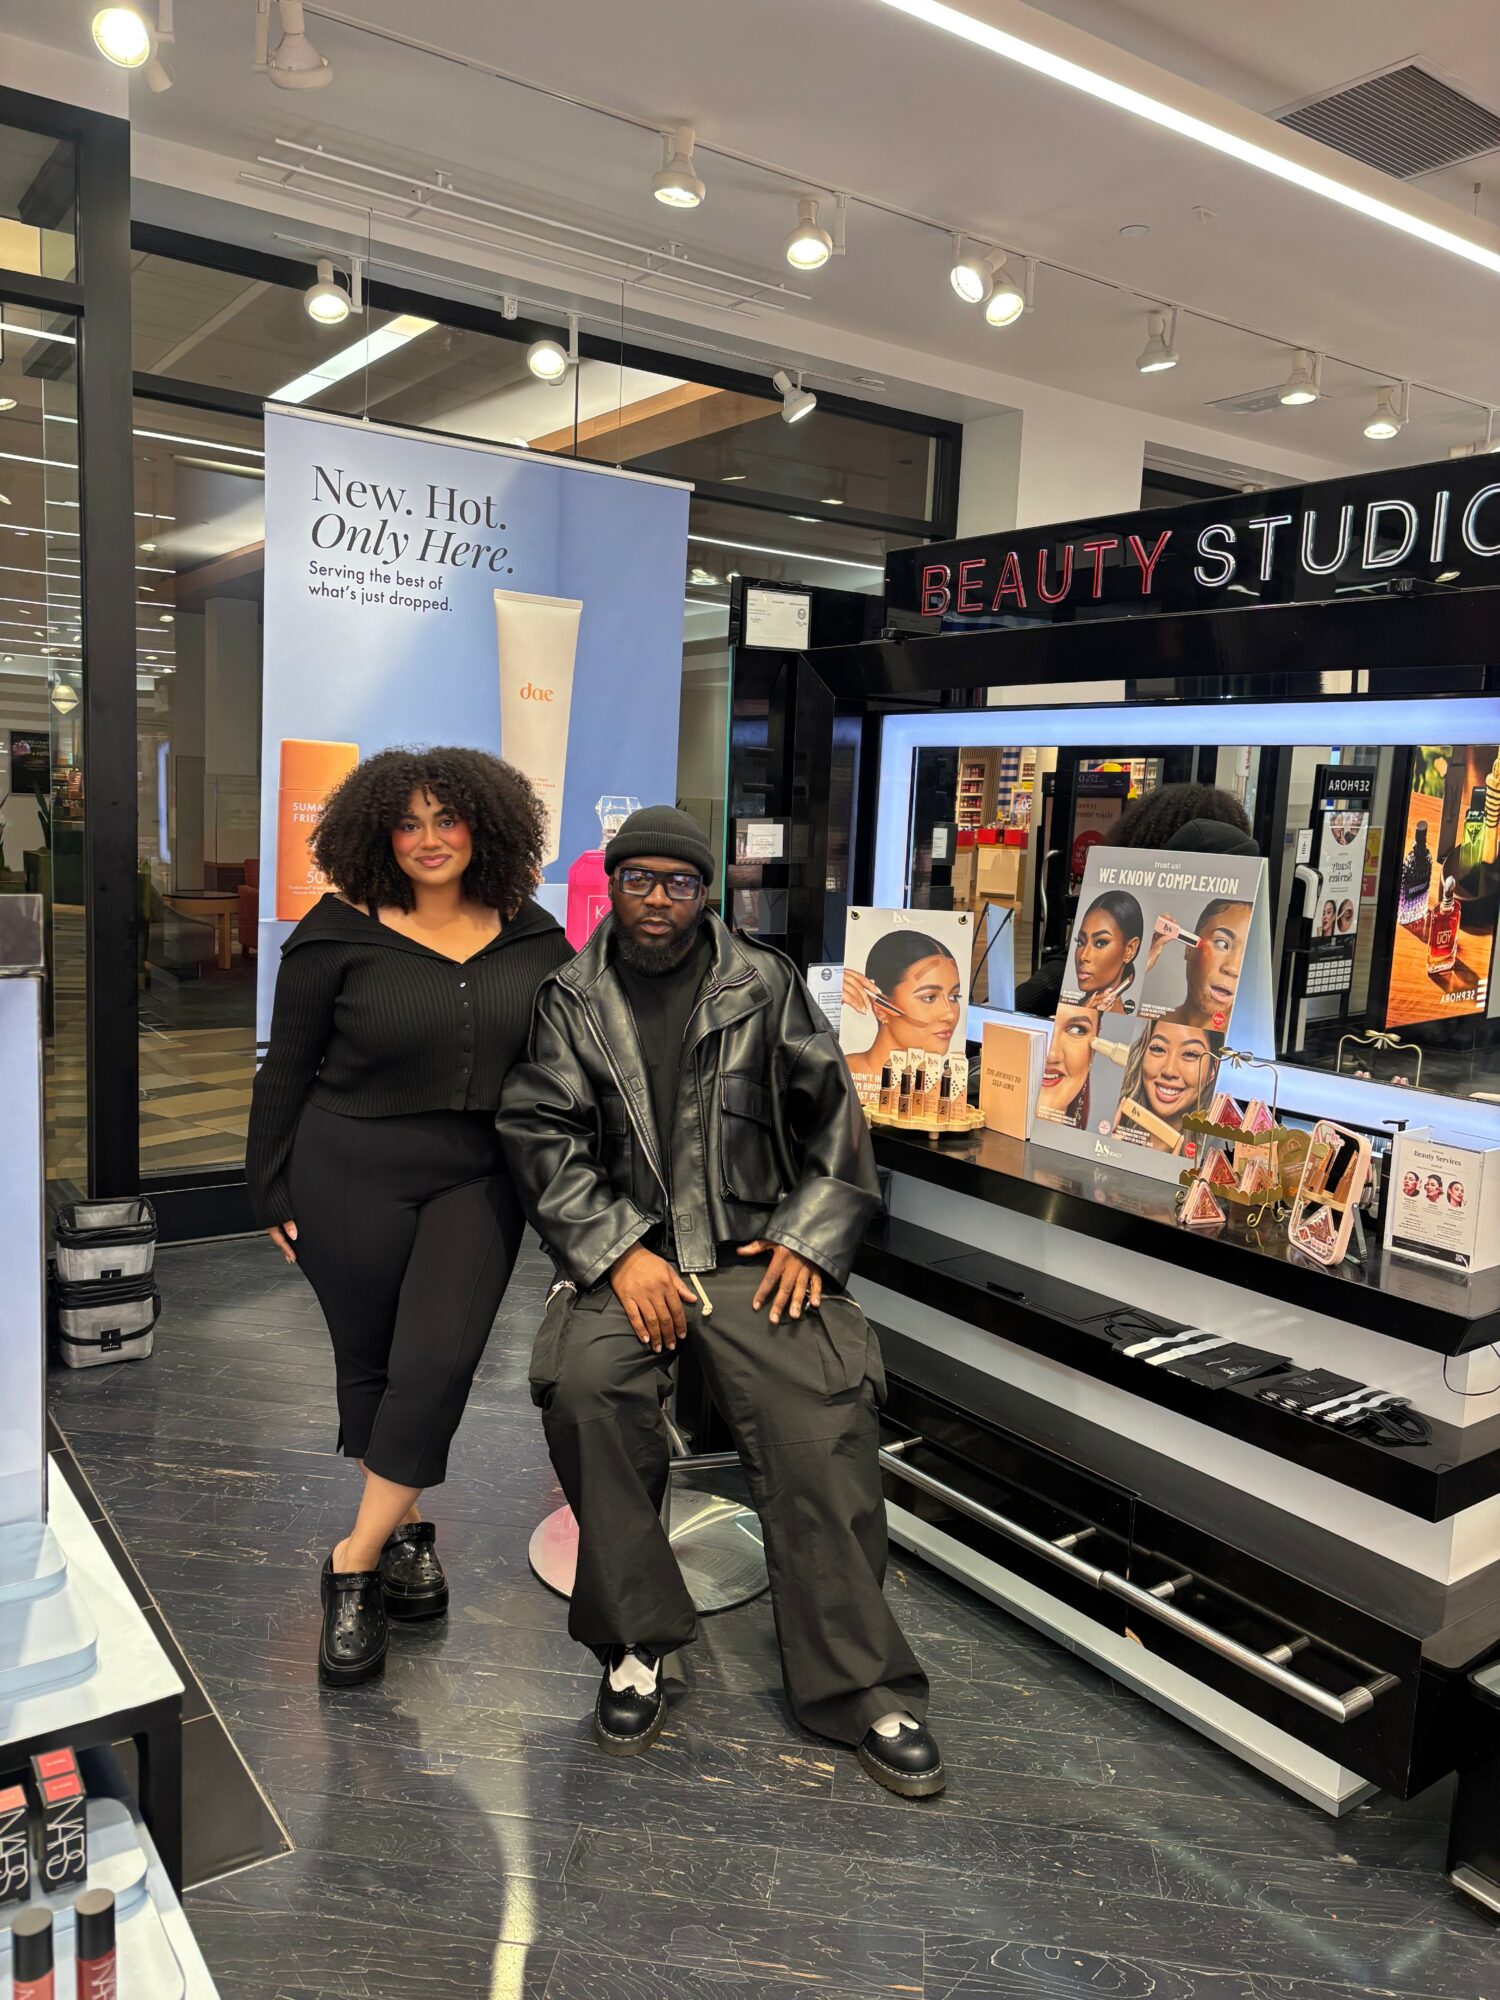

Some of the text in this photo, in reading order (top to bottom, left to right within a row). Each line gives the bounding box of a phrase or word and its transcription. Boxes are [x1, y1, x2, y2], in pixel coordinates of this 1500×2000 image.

[312, 465, 507, 530] New. Hot.
[311, 513, 514, 574] Only Here.
[309, 560, 443, 590] Serving the best of
[921, 530, 1173, 617] BEAUTY
[361, 588, 385, 605] just
[389, 590, 453, 613] dropped.
[519, 682, 554, 702] dae
[1099, 867, 1240, 895] WE KNOW COMPLEXION
[595, 904, 605, 920] K
[1414, 1150, 1462, 1167] Beauty Services
[45, 1796, 86, 1880] NARS
